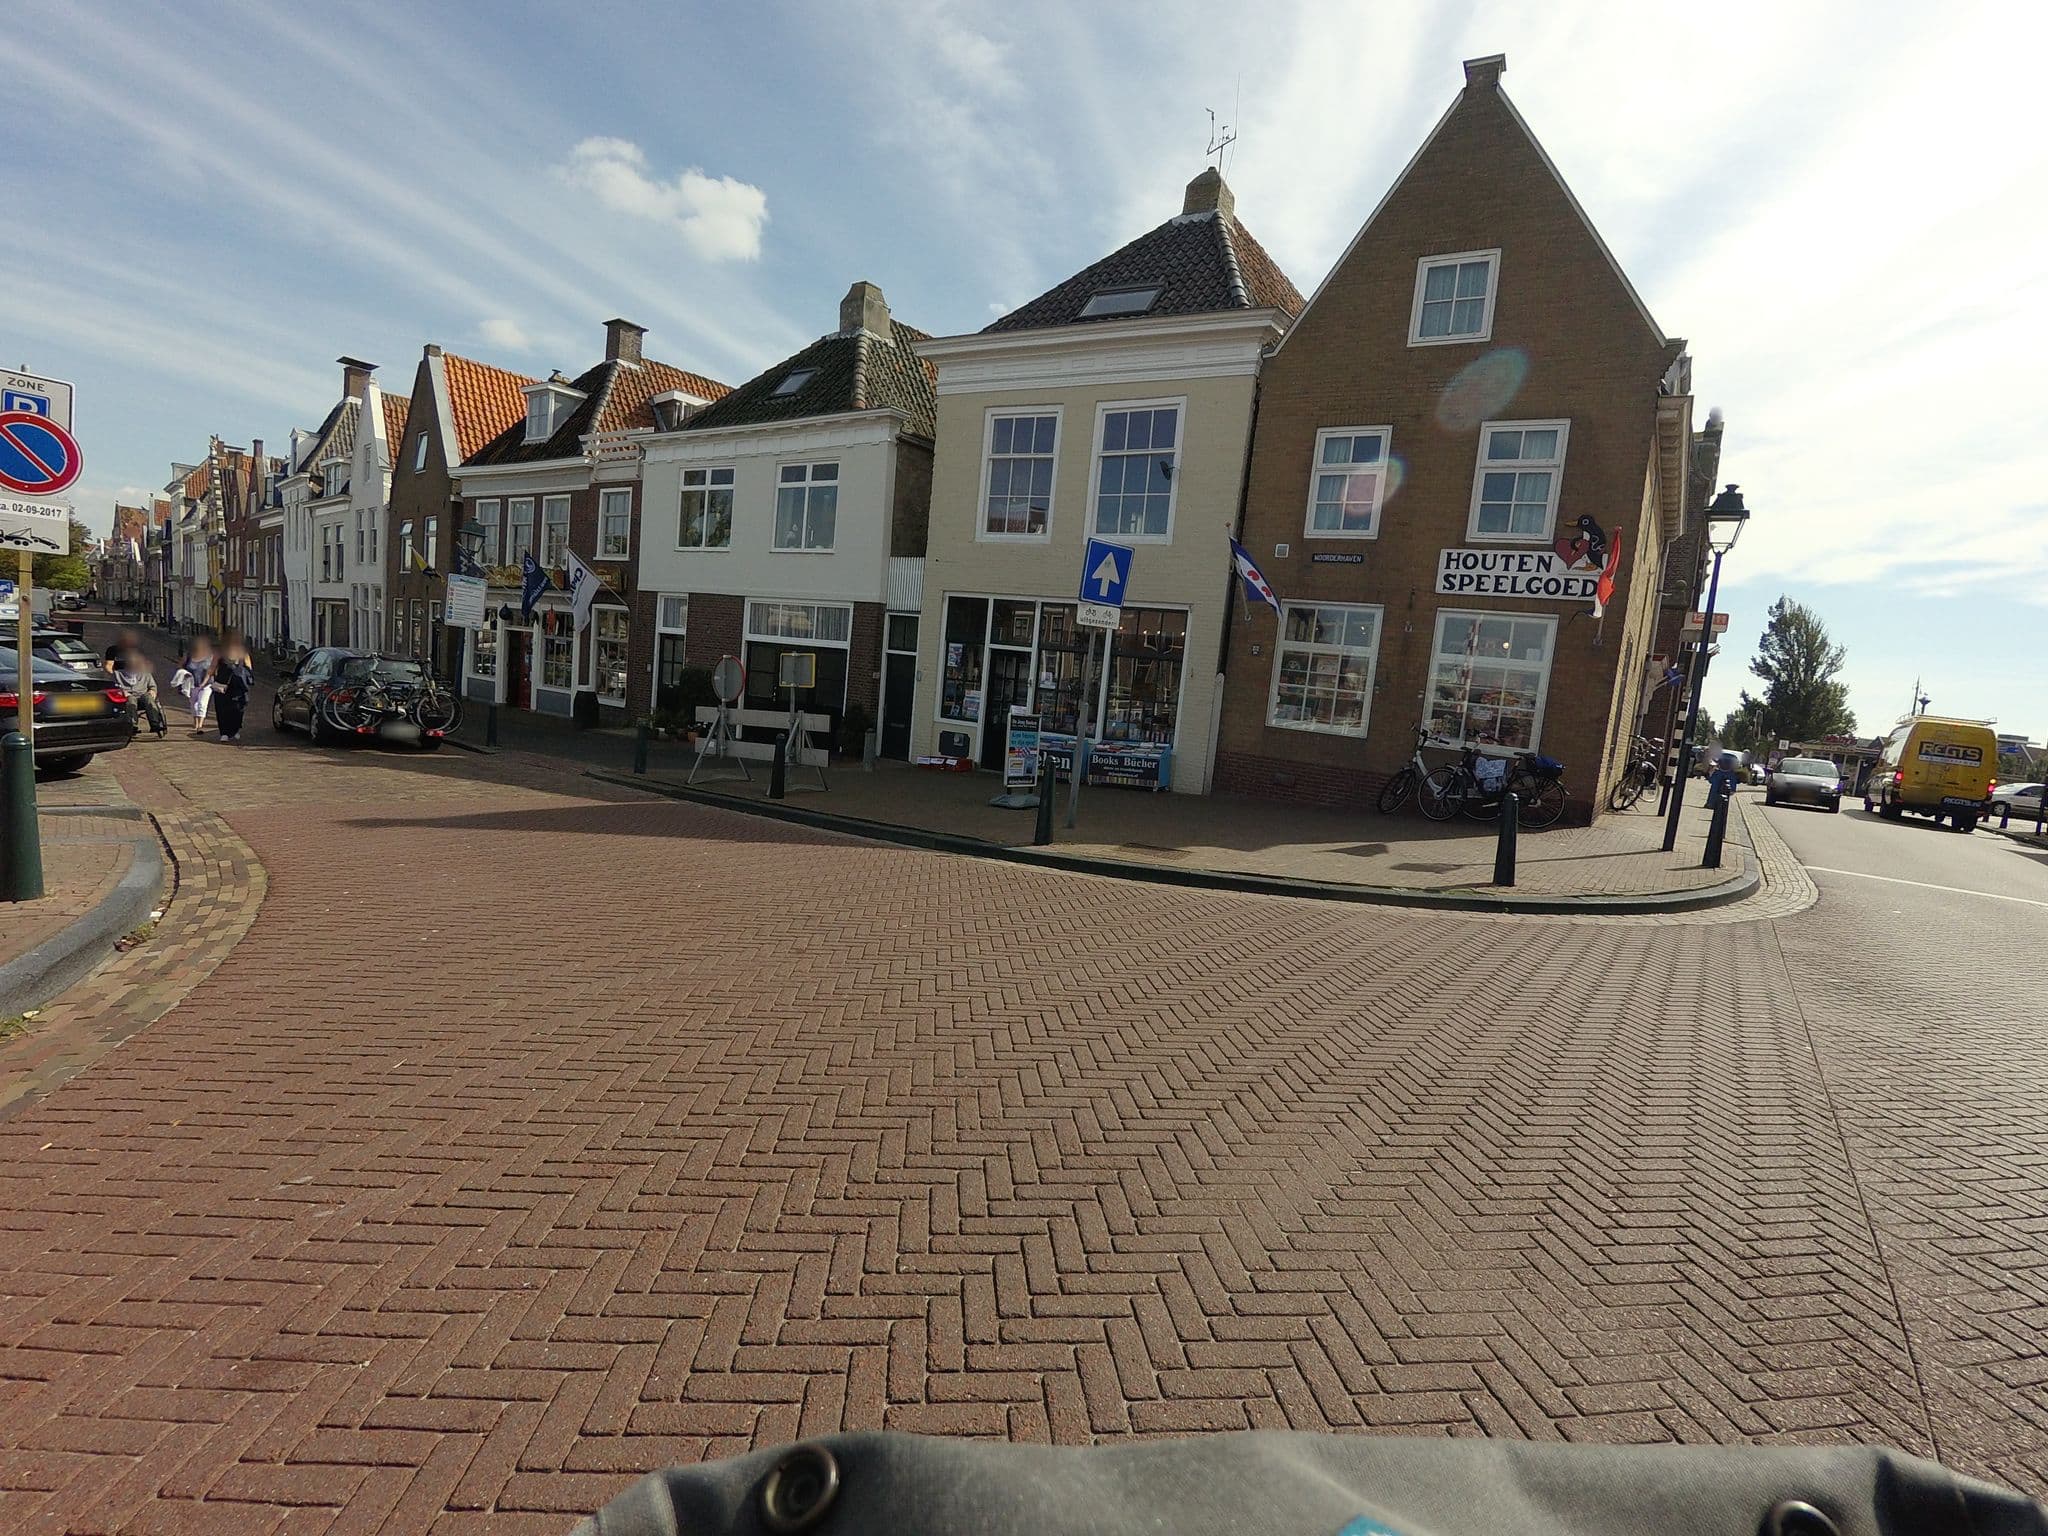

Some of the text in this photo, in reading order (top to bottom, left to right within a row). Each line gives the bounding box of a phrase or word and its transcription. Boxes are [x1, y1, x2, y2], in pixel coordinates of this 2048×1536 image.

[8, 377, 45, 392] ZONE
[12, 503, 62, 518] 02-09-2017
[1444, 551, 1554, 573] HOUTEN
[1442, 574, 1598, 597] SPEELGOED
[1080, 617, 1117, 626] uitgezonder
[1922, 744, 1980, 760] REGTS
[1092, 755, 1158, 769] Books Bücher
